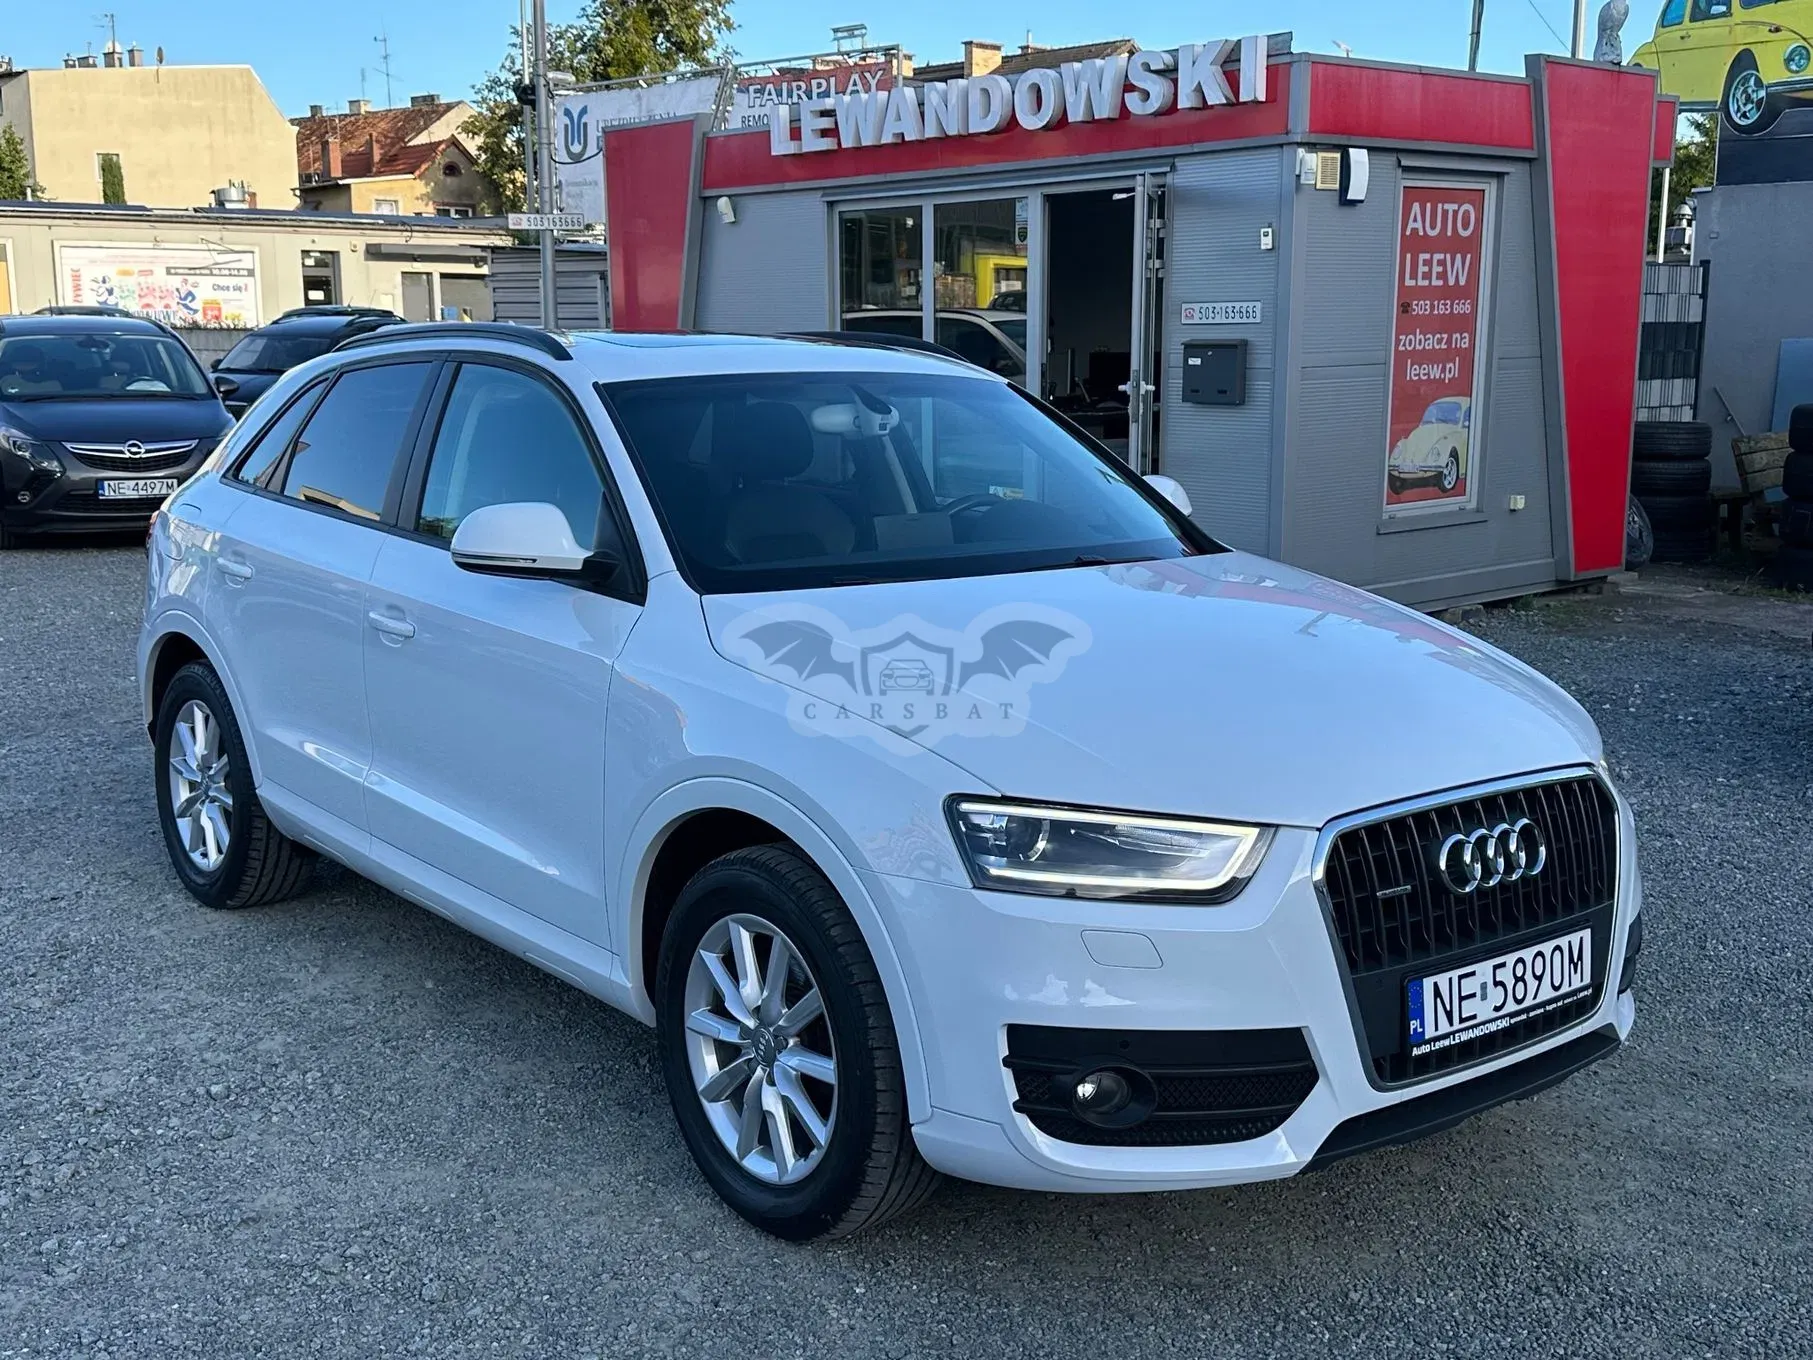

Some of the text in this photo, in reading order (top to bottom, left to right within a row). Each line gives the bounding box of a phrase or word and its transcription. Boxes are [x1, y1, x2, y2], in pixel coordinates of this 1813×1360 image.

[748, 70, 884, 108] FAIRPLAY
[770, 35, 1267, 155] LEWANDOWSKI
[1405, 202, 1476, 237] AUTO
[1404, 253, 1472, 287] LEEW
[1411, 300, 1471, 315] 503 163 666
[1399, 328, 1469, 351] zobacz na
[1406, 357, 1460, 383] leew.pl
[107, 480, 175, 495] NE 4497M
[1432, 935, 1584, 1032] NE 5890M
[1409, 1018, 1423, 1035] PL
[1411, 1044, 1430, 1057] Auto
[1431, 1038, 1450, 1051] Leew
[1450, 1016, 1510, 1045] LEWANDOWSKI
